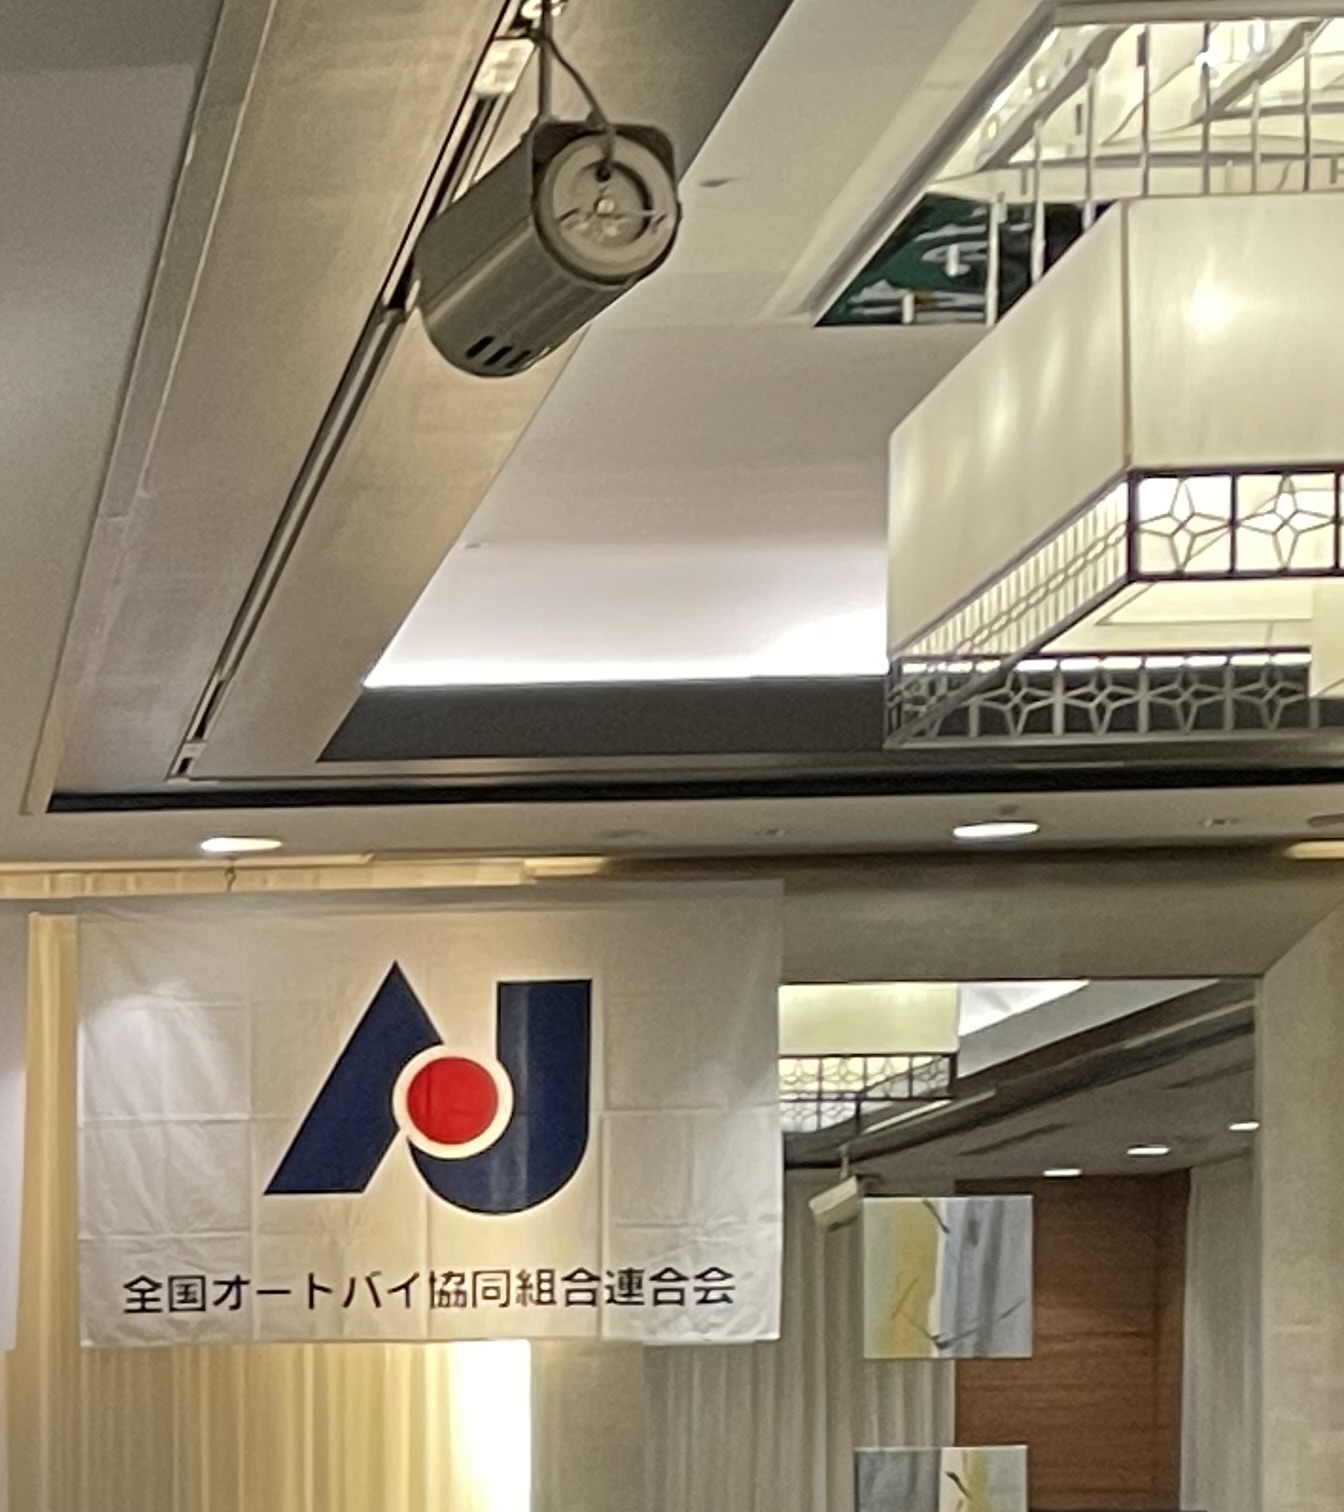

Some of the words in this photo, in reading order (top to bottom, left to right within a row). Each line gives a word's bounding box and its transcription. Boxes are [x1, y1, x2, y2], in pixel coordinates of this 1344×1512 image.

[122, 1266, 736, 1316] 全国オートバイ協同組合連合会
